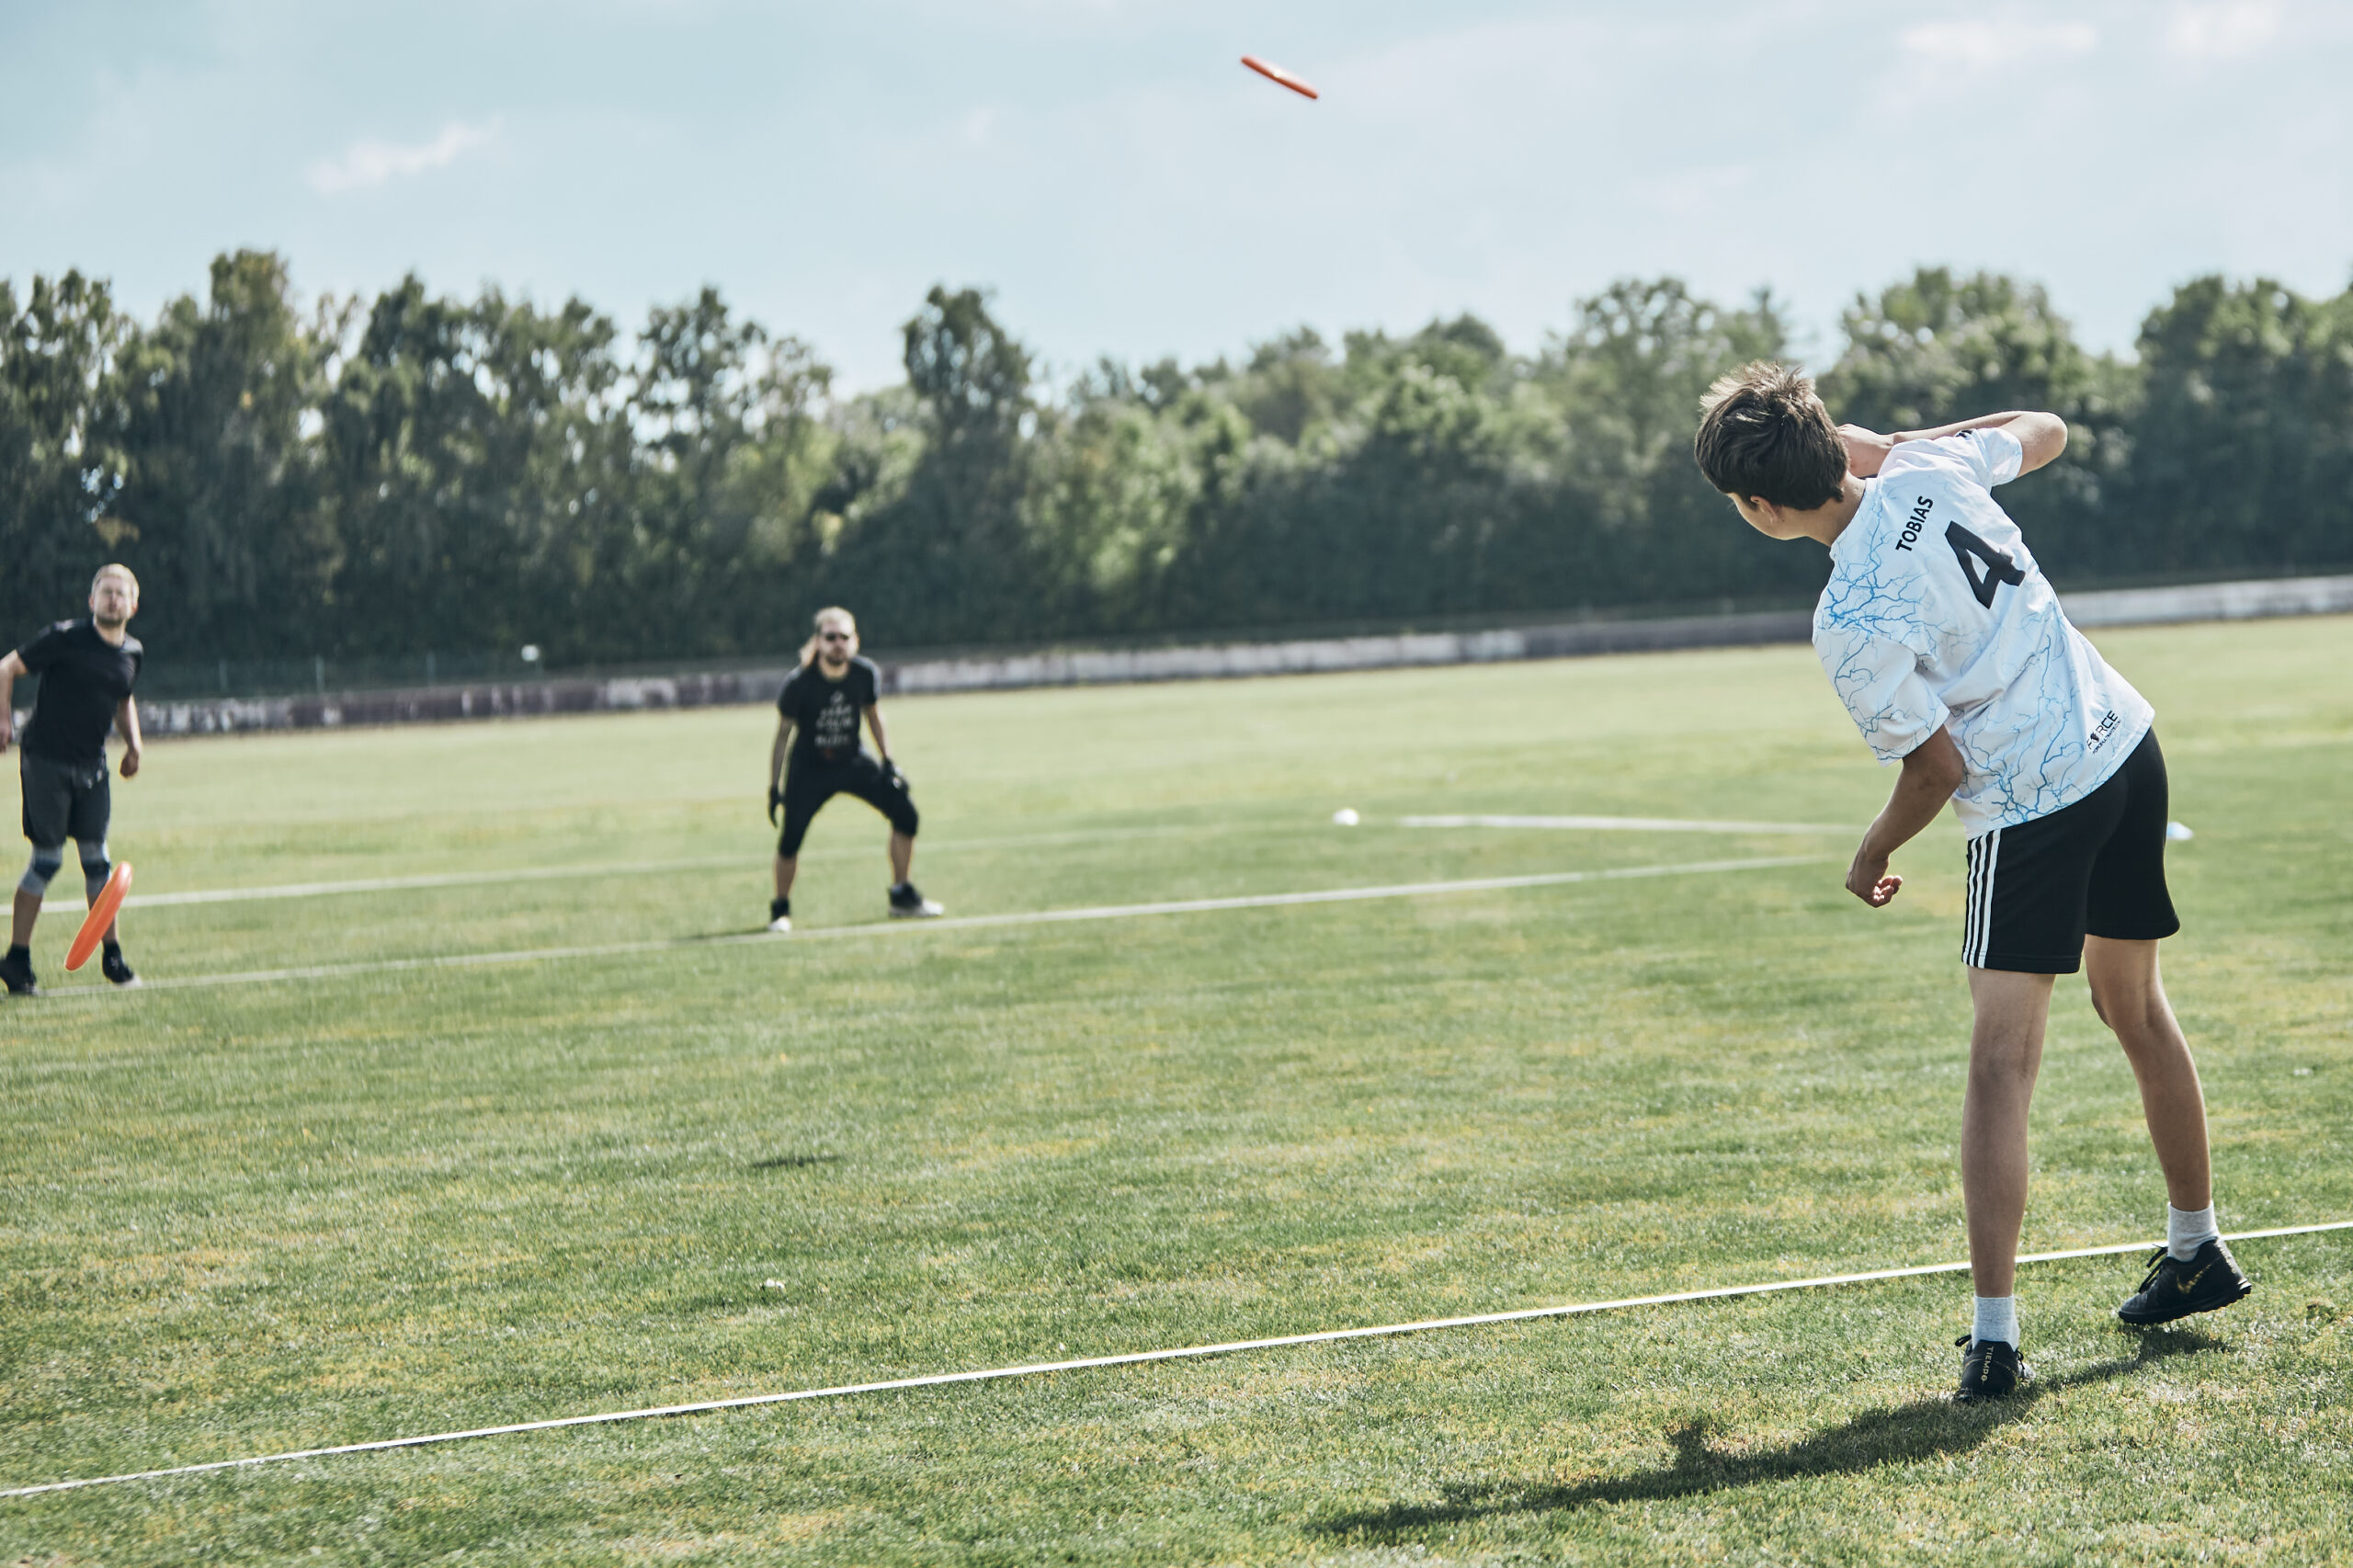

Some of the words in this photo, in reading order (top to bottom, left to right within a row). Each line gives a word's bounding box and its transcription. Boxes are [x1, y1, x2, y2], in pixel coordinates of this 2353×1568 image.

[1895, 495, 1933, 551] TOBIAS
[1945, 520, 2025, 609] 4
[1981, 1346, 1994, 1381] TIEMPO
